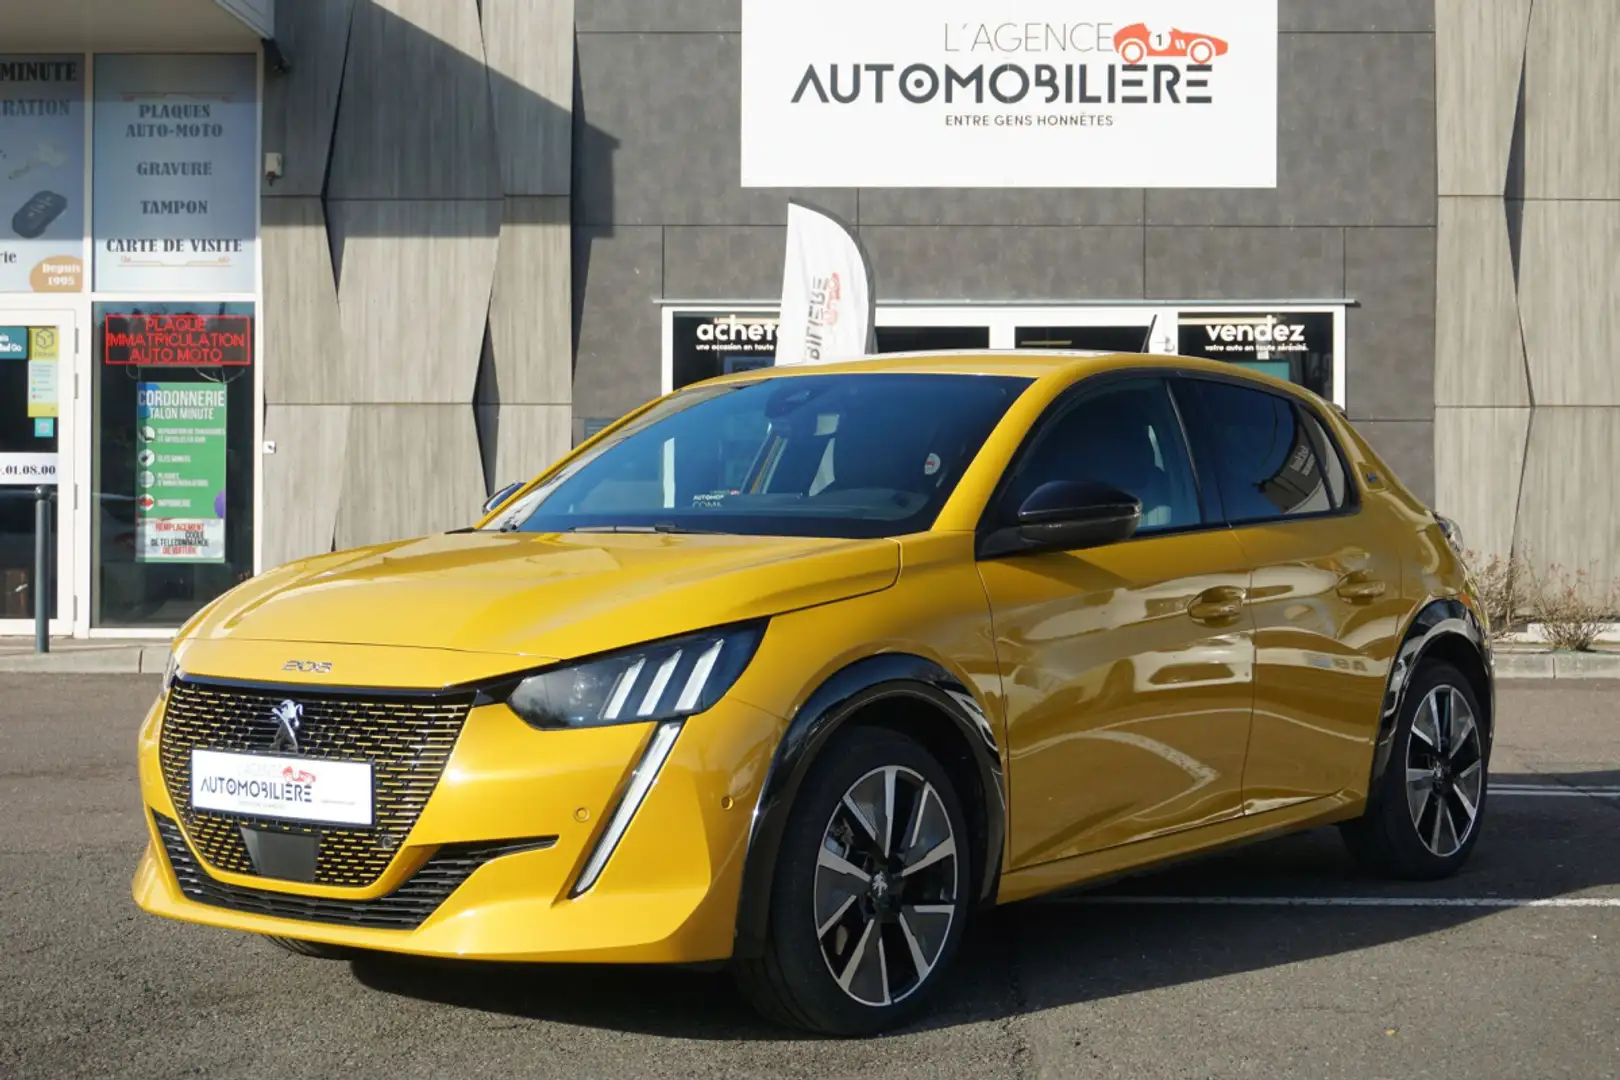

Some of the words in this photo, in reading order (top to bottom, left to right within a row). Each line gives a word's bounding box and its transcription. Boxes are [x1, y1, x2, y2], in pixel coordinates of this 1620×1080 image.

[0, 62, 77, 81] MINUTE
[2, 98, 70, 117] RATION
[139, 104, 211, 118] PLAQUES
[945, 115, 990, 127] ENTRE
[994, 115, 1033, 127] GENS
[125, 124, 223, 138] AUTO-MOTO
[137, 161, 212, 176] GRAVURE
[141, 200, 208, 214] TAMPON
[106, 238, 158, 253] CARTE
[163, 238, 184, 253] DE
[191, 238, 242, 253] VISITE
[42, 263, 81, 275] Depuis
[145, 317, 206, 332] PLAQUE
[696, 314, 780, 341] achet
[1205, 315, 1305, 342] vendez
[711, 342, 742, 351] occasion
[754, 343, 774, 351] toute
[1225, 344, 1243, 352] auto
[130, 347, 174, 362] AUTO
[177, 347, 223, 362] MOTO
[138, 389, 225, 407] CORDONNERIE
[149, 407, 178, 420] TALON
[180, 407, 214, 420] MINUTE
